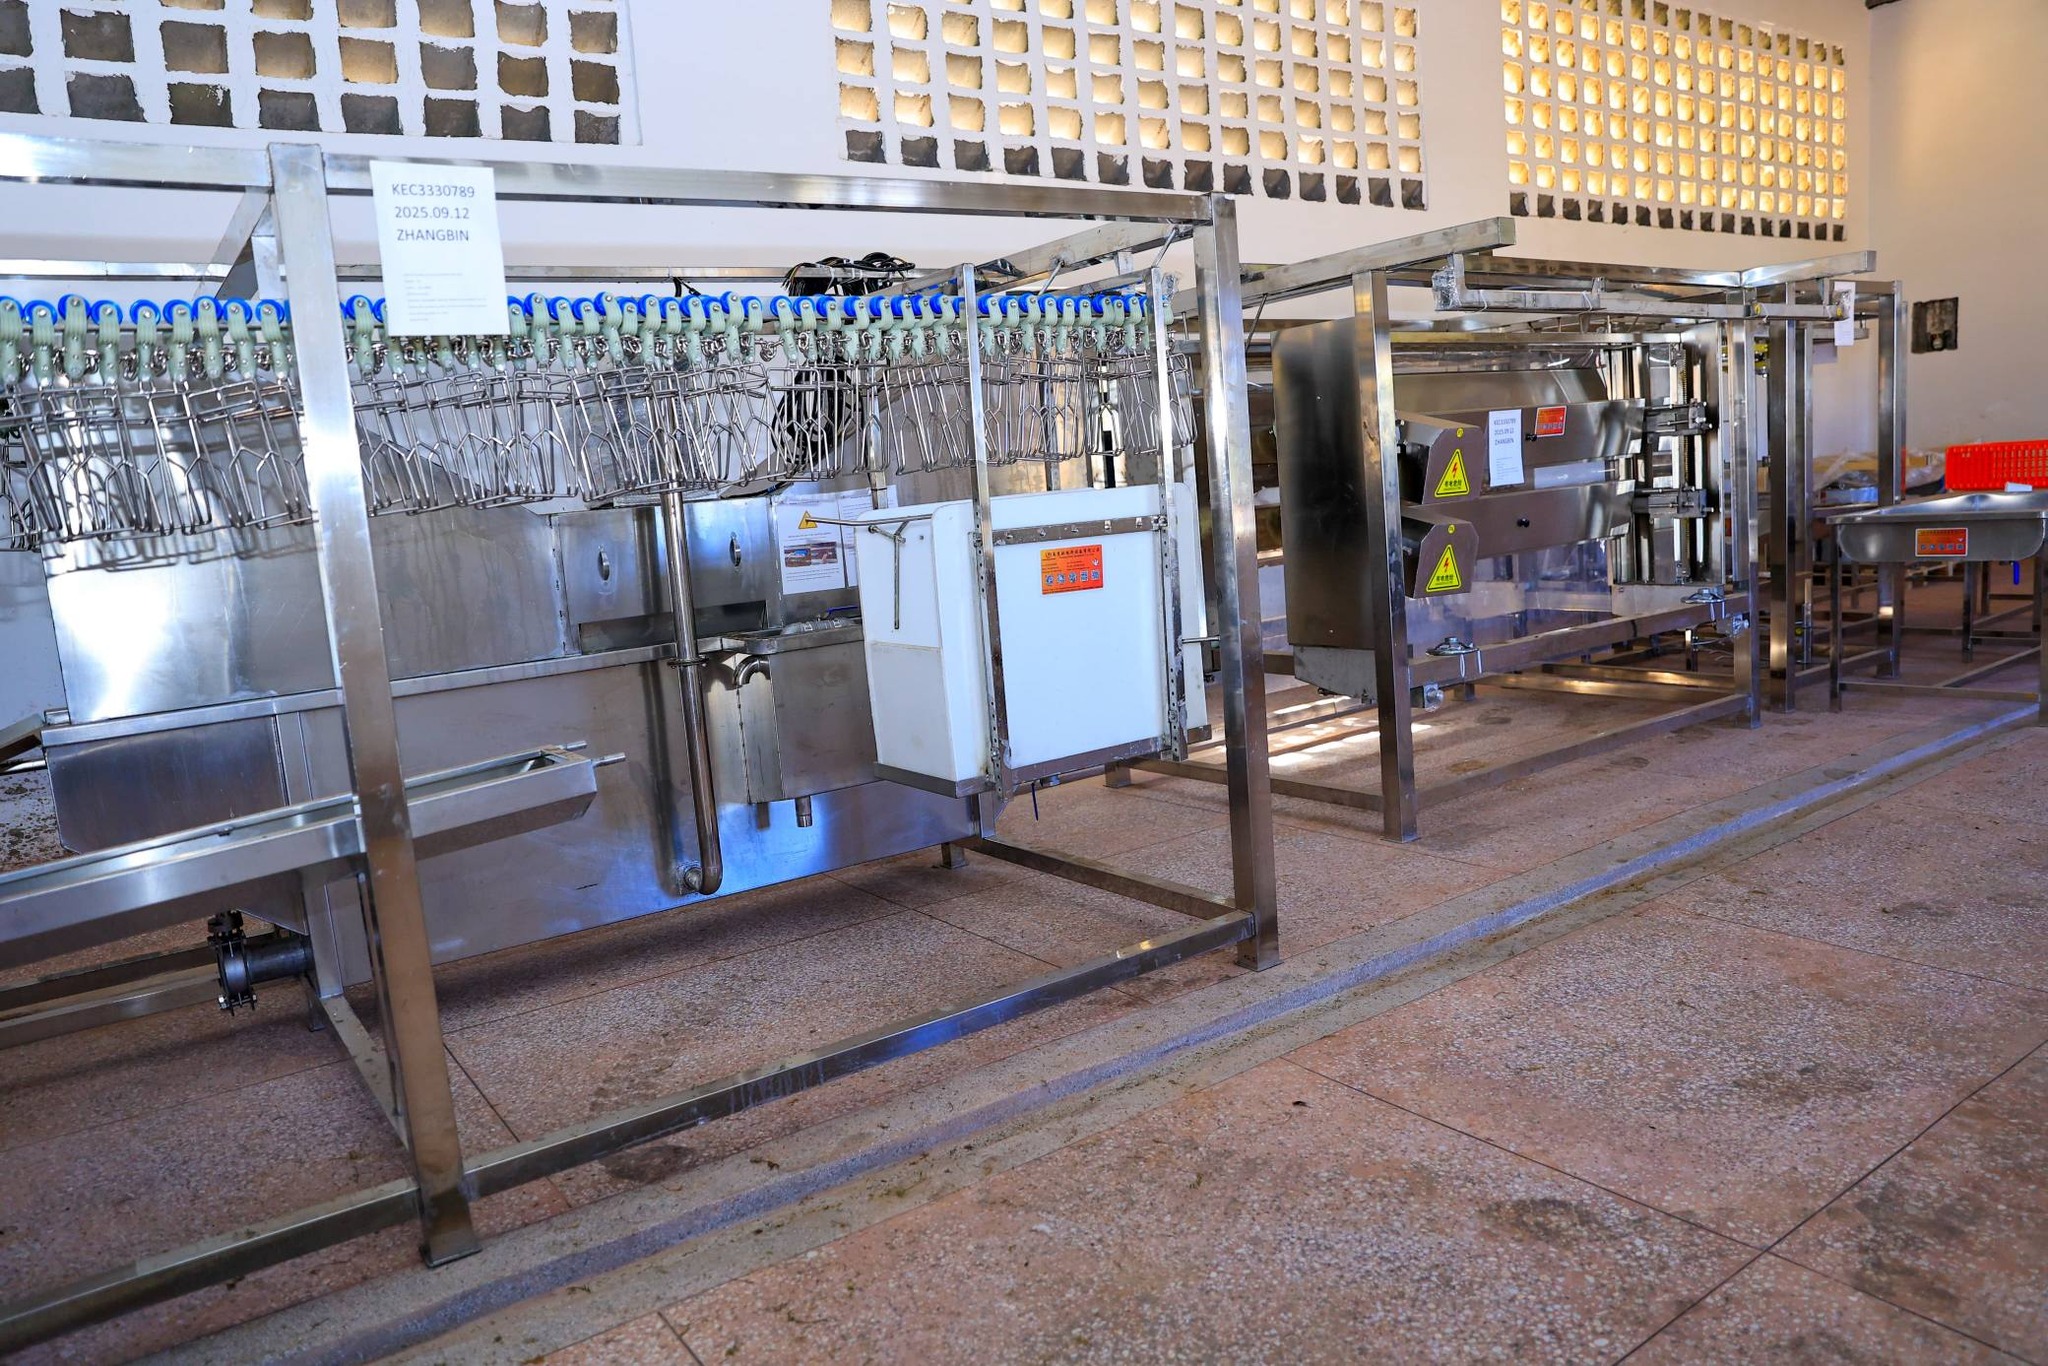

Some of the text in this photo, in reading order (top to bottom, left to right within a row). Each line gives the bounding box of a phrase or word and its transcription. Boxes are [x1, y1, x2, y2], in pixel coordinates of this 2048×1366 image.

[391, 183, 475, 198] KEC3330789
[395, 206, 470, 219] 2025.09.12
[396, 229, 470, 242] ZHANGBIN
